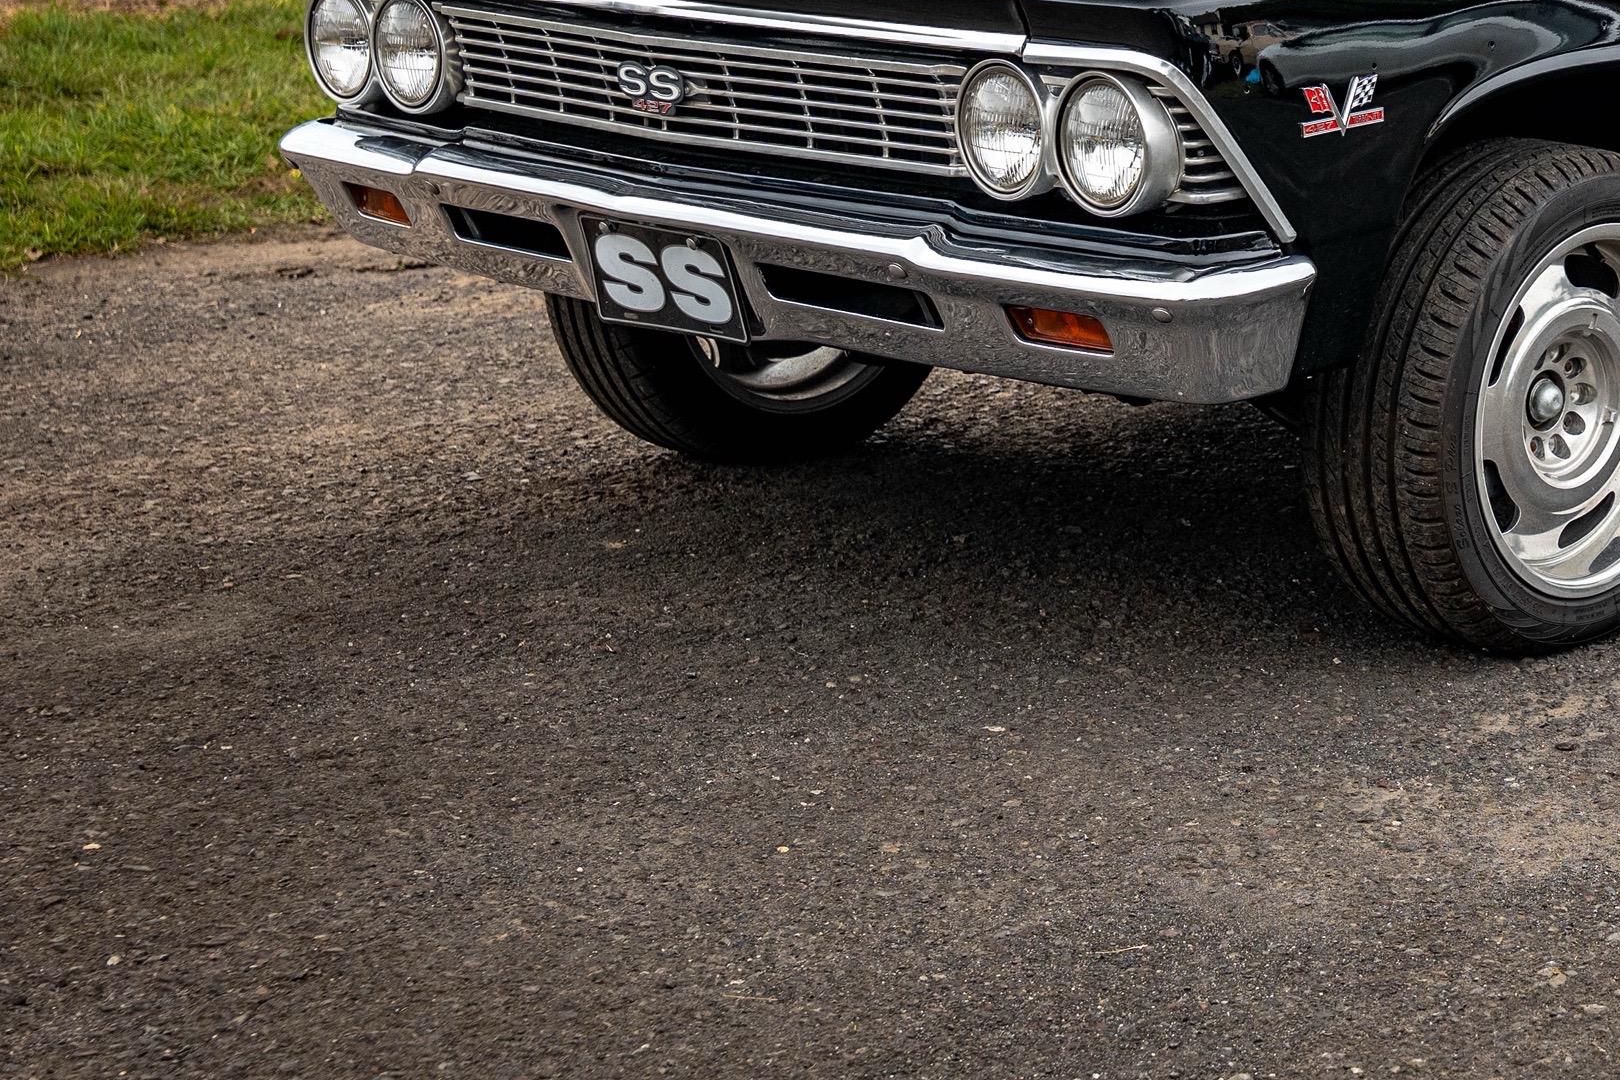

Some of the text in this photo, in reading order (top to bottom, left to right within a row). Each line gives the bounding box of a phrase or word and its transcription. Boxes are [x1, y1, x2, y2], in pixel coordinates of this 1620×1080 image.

[619, 64, 682, 101] SS
[633, 98, 673, 115] 427
[1305, 120, 1334, 133] 427
[595, 233, 733, 325] SS
